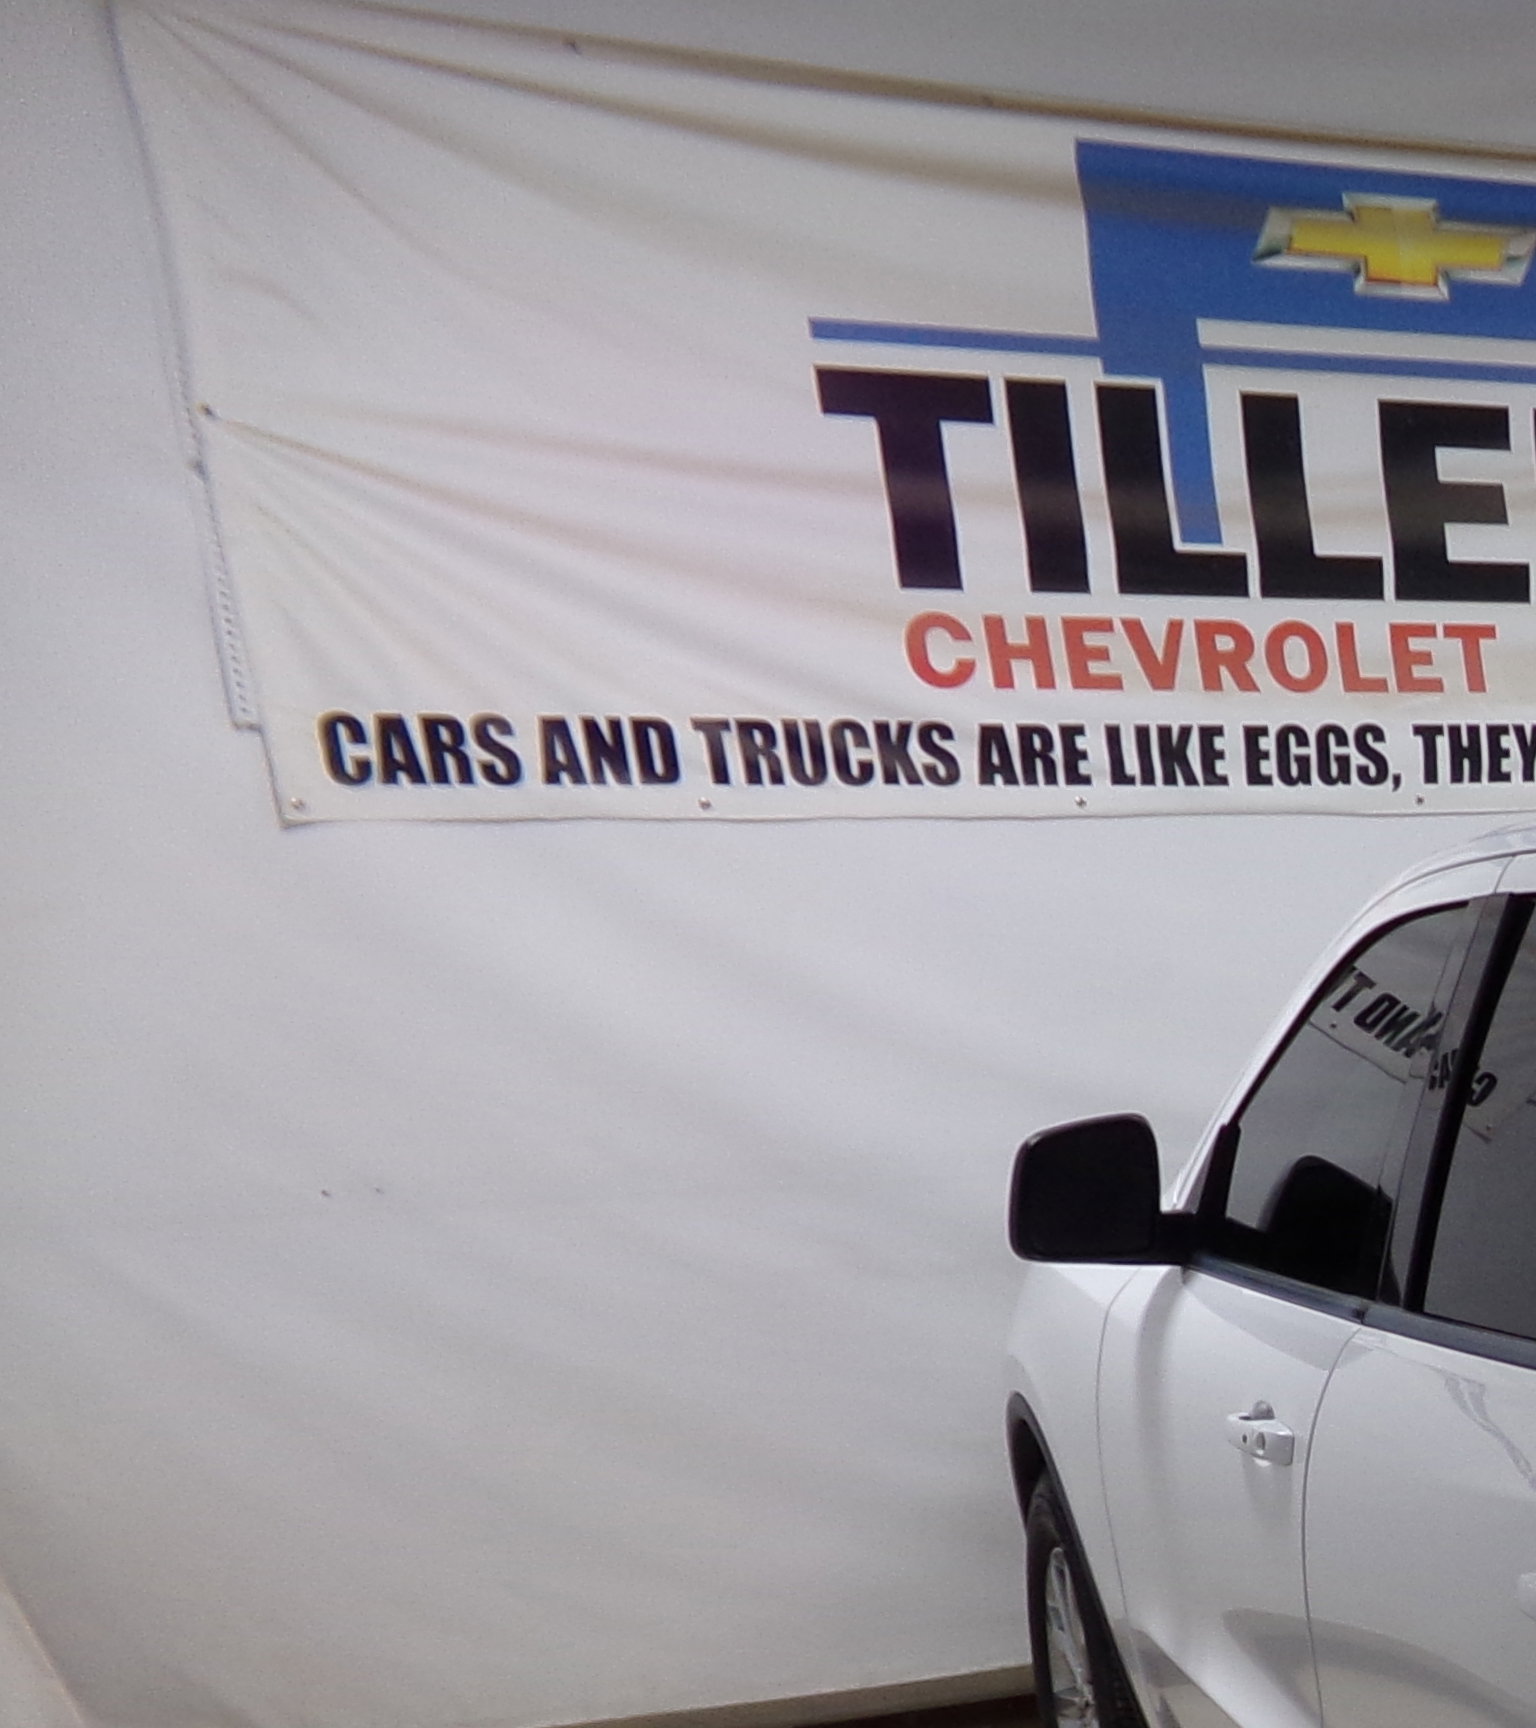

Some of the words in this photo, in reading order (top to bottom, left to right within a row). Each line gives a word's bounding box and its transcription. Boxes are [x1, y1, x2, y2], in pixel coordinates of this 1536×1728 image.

[904, 611, 1497, 696] CHEVROLET
[318, 711, 524, 787] CARS
[538, 714, 681, 786] AND
[689, 717, 961, 788] TRUCKS
[976, 723, 1093, 786] ARE
[1105, 723, 1230, 787] LIKE
[1243, 722, 1402, 793] EGGS,
